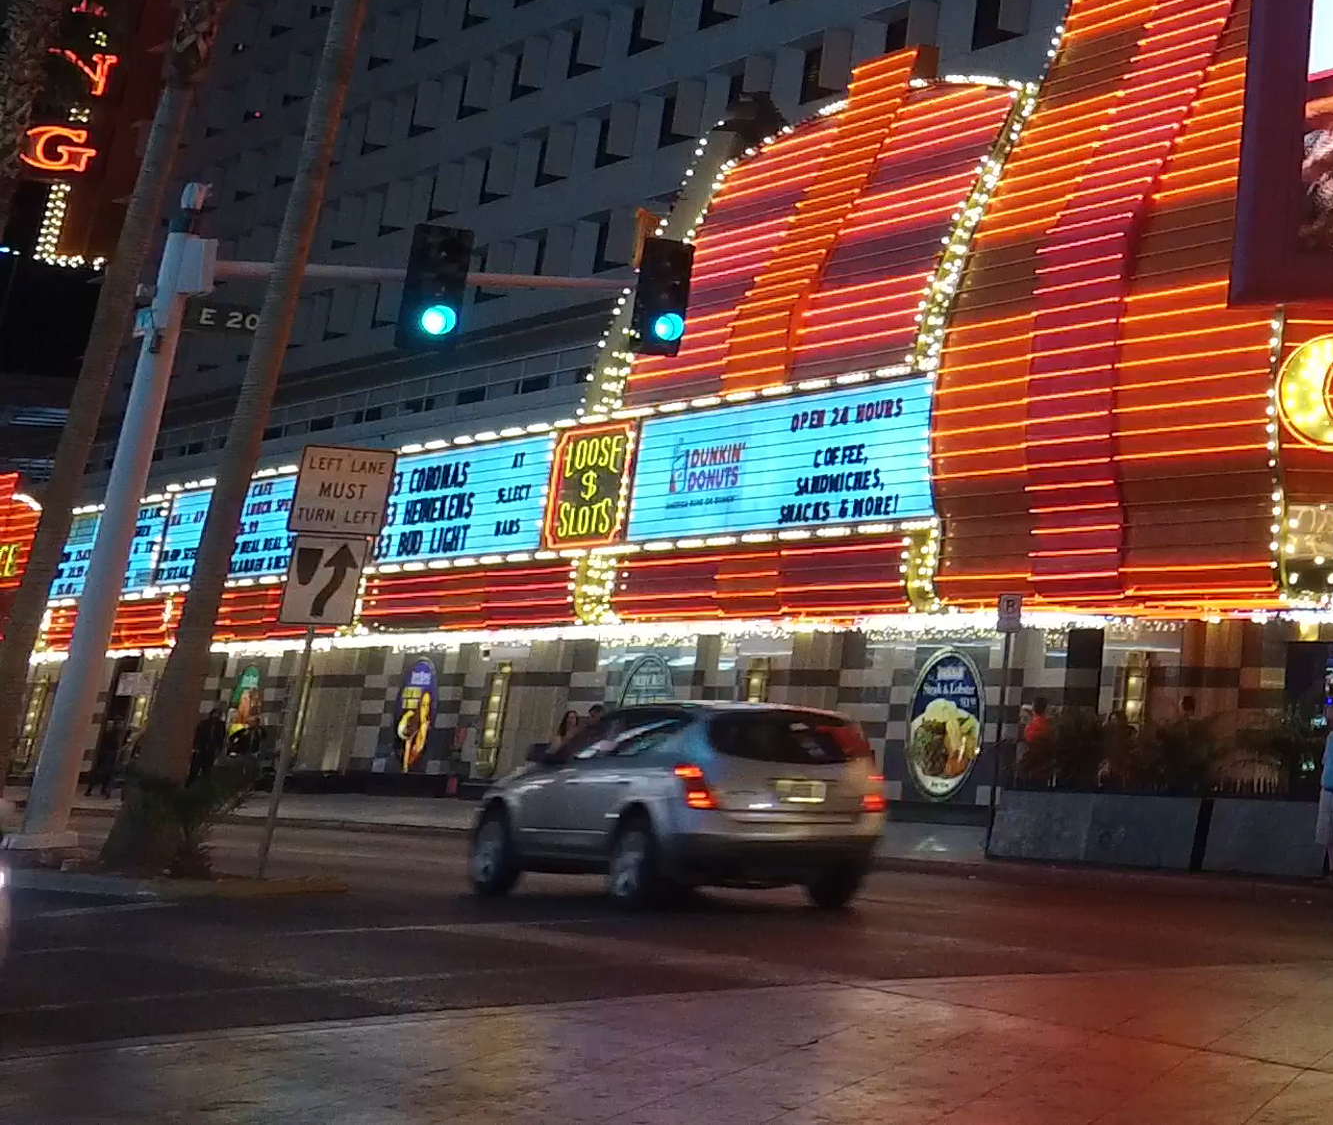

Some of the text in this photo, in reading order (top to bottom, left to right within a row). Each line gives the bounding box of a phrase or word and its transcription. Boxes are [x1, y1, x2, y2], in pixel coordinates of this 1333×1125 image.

[200, 307, 218, 326] E
[790, 397, 904, 433] OPEN 24 HOURS
[309, 456, 388, 475] LEFT LANE
[564, 434, 625, 478] LOOSE
[689, 441, 747, 468] DUNKIN'
[813, 443, 869, 469] COFFEE,
[318, 481, 368, 501] MUST
[409, 461, 472, 495] CORONAS
[580, 469, 598, 501] $
[687, 466, 741, 493] DONUTS
[794, 467, 884, 497] SANDWICHES,
[494, 484, 532, 505] SELECT
[298, 507, 379, 525] TURN LEFT
[557, 497, 613, 539] SLOTS
[778, 493, 900, 525] SNACKS & MORE!
[397, 530, 424, 557] BUD
[428, 524, 472, 555] LIGHT
